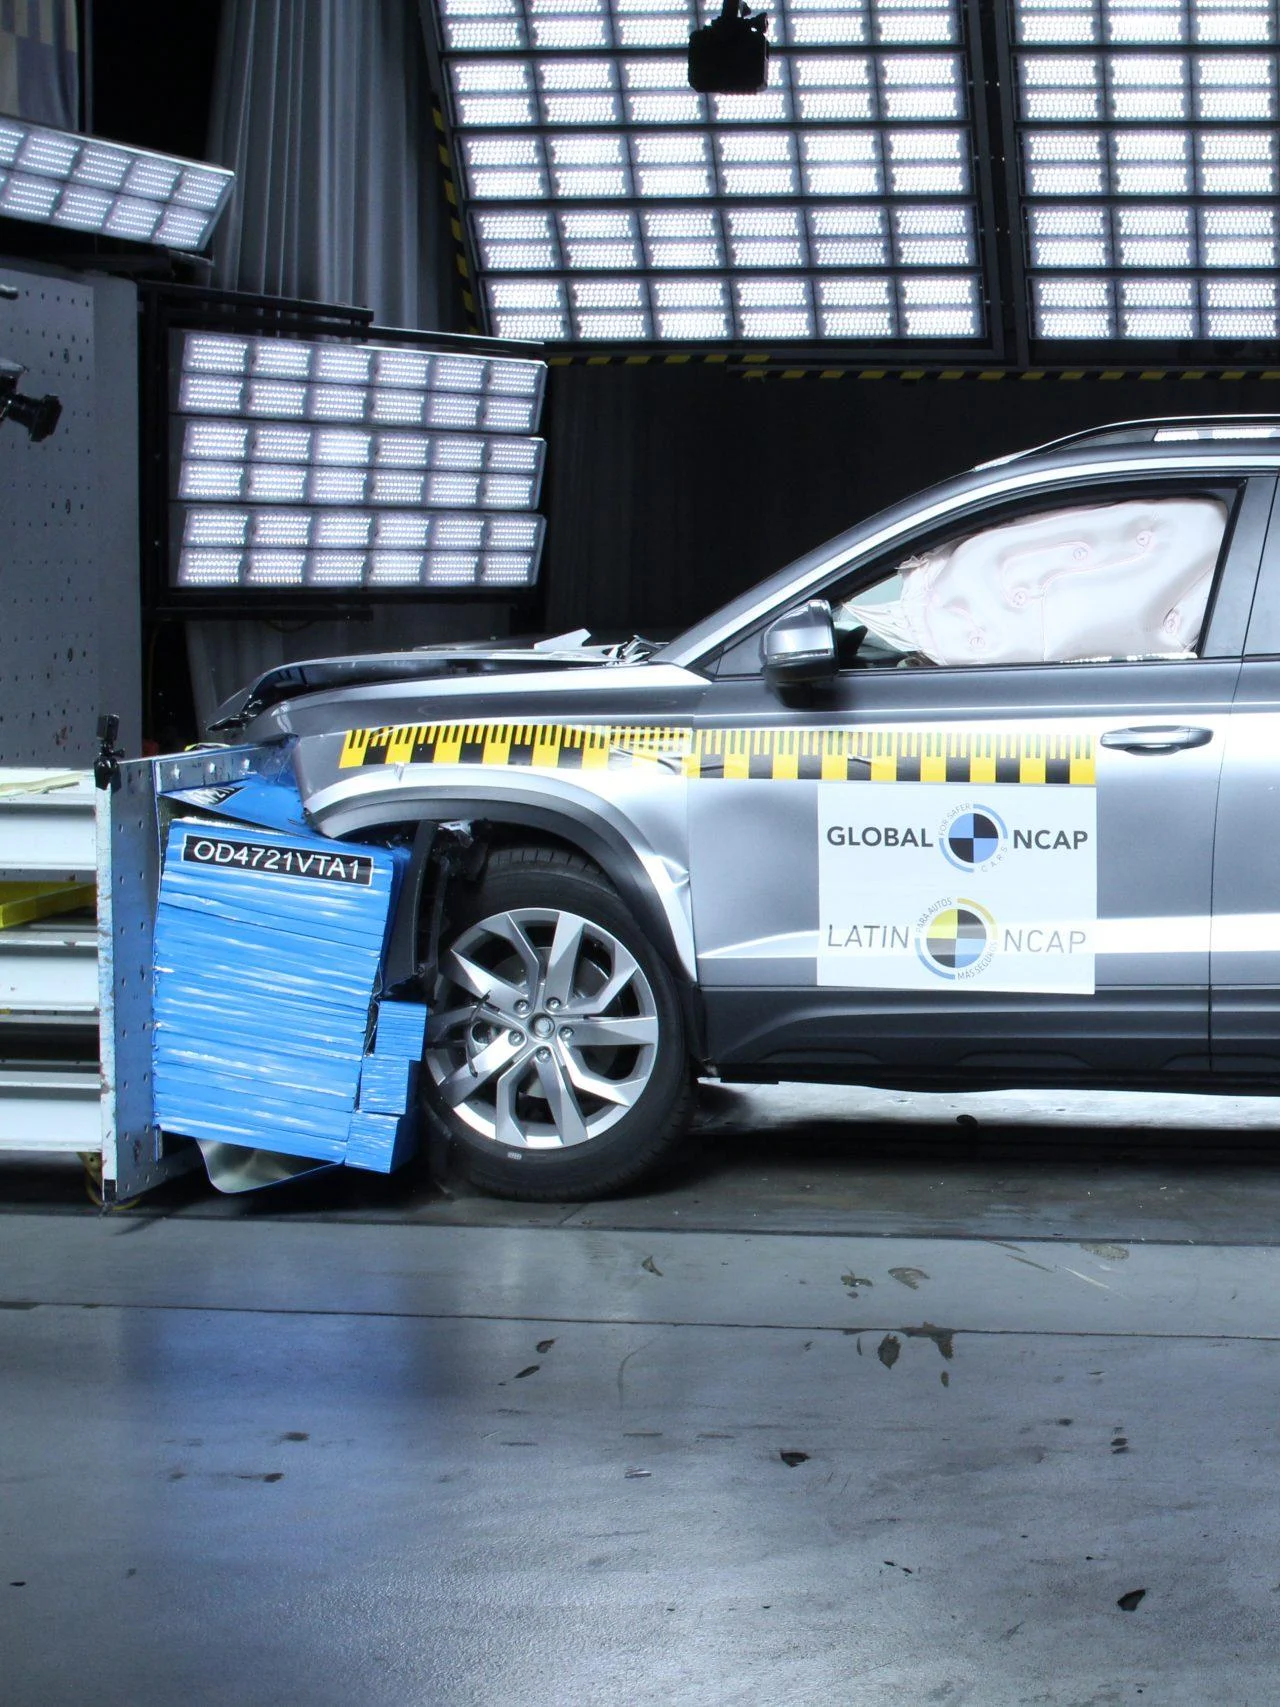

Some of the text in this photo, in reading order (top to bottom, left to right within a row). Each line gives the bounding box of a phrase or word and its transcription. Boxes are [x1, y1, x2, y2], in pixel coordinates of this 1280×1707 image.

[939, 803, 971, 836] FOR SAFER
[827, 826, 934, 847] GLOBAL
[1013, 829, 1088, 850] NCAP
[193, 840, 360, 880] OD4721VTA1
[981, 846, 1008, 873] CARS
[928, 897, 952, 914] AUTOS
[828, 924, 909, 949] LATIN
[1004, 928, 1086, 954] NCAP
